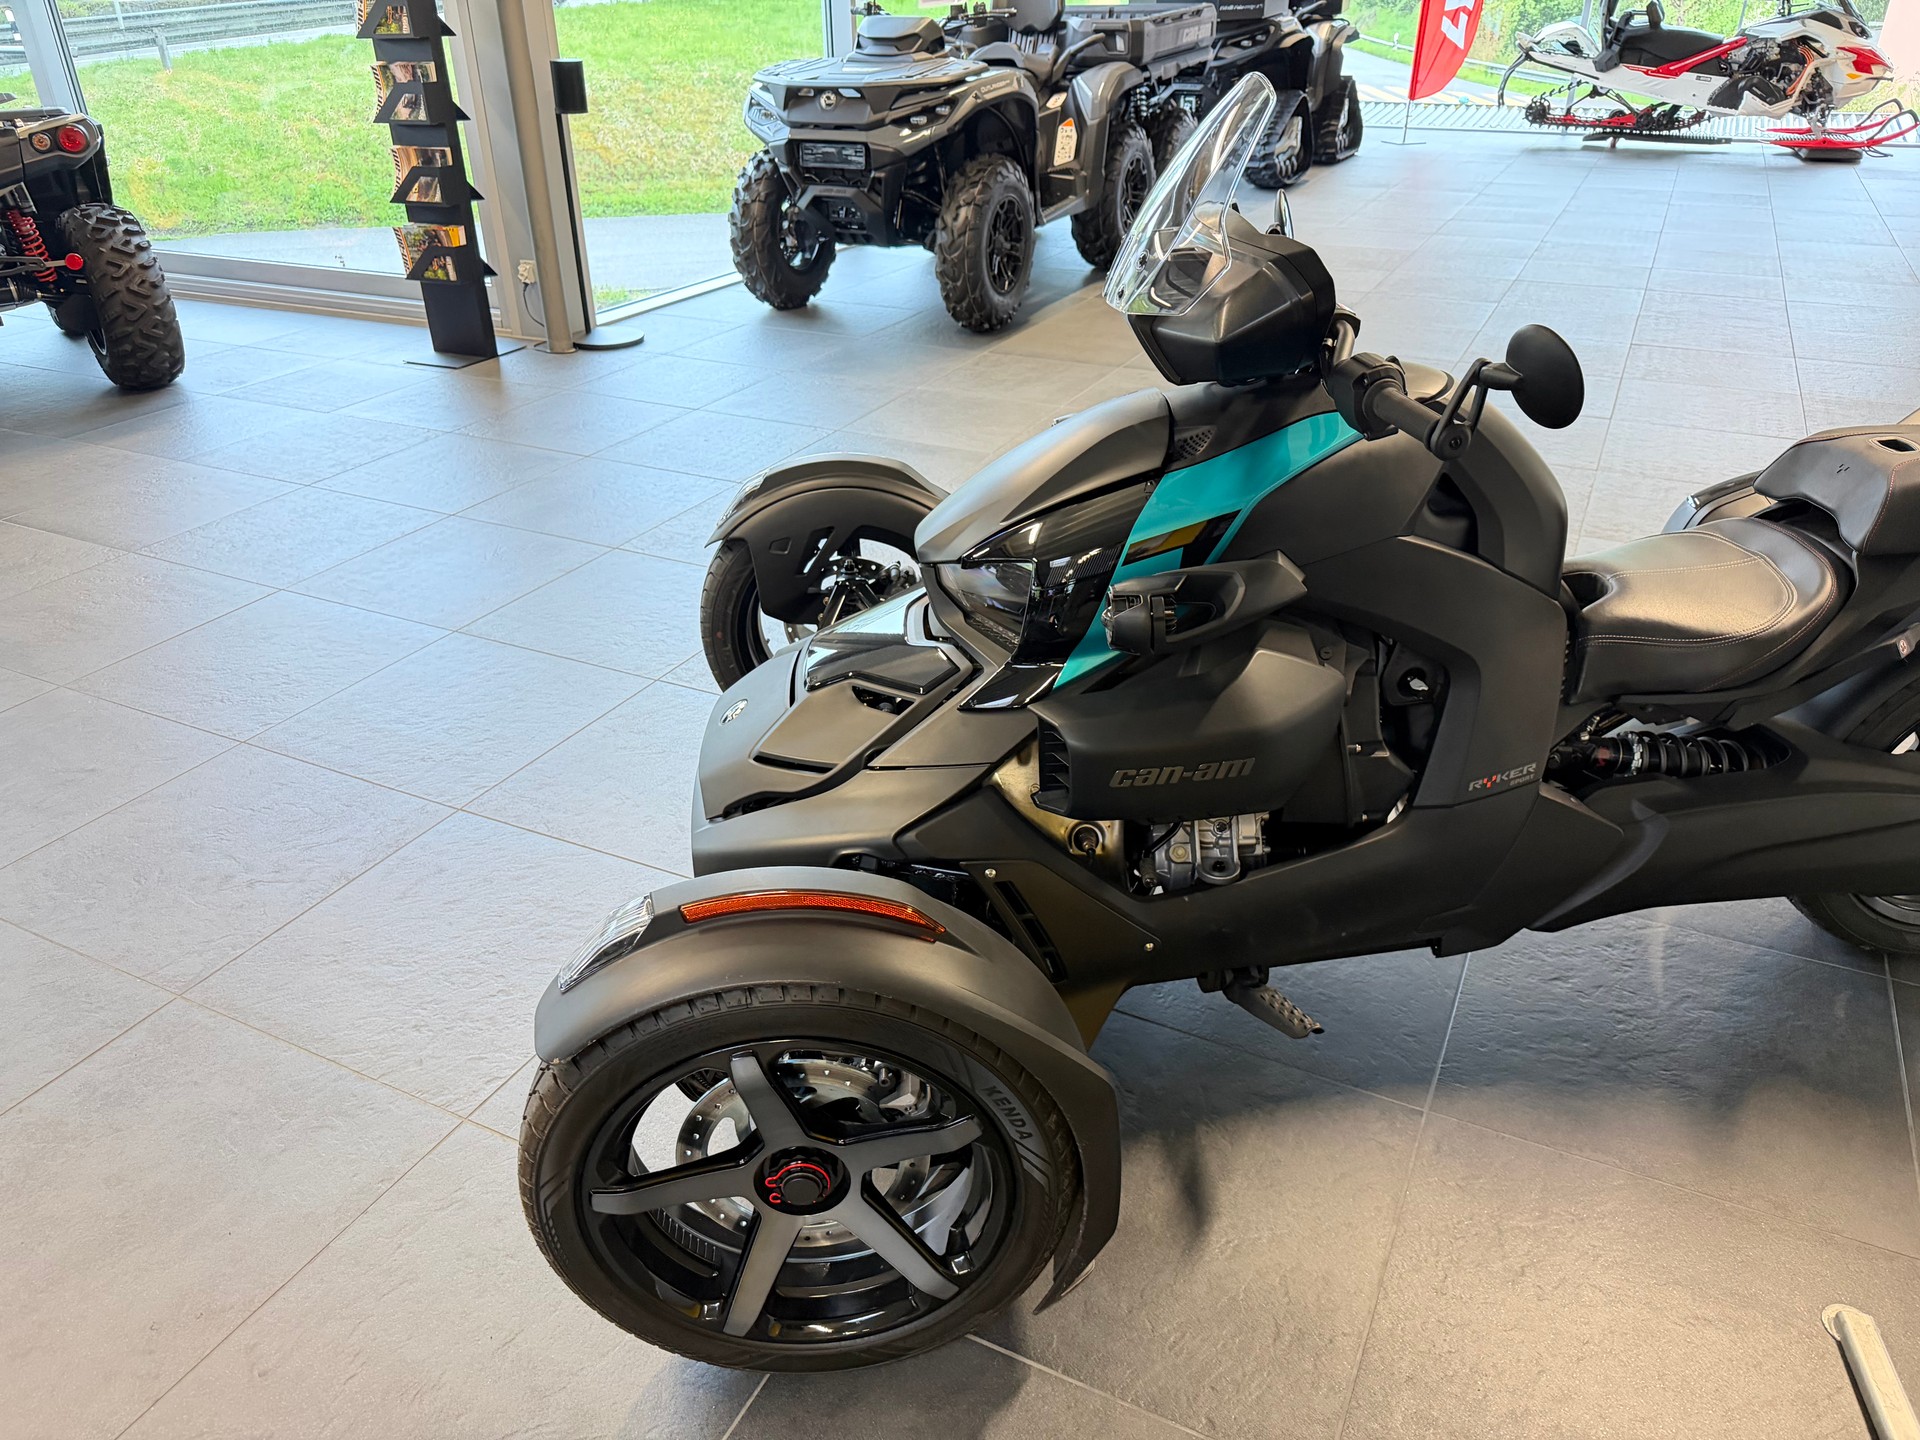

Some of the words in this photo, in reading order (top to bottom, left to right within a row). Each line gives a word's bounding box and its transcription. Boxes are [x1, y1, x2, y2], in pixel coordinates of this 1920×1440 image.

[1109, 757, 1256, 788] can-am
[1468, 762, 1537, 791] RYKER
[1509, 774, 1535, 786] SPORT
[980, 1085, 1034, 1140] KENDA
